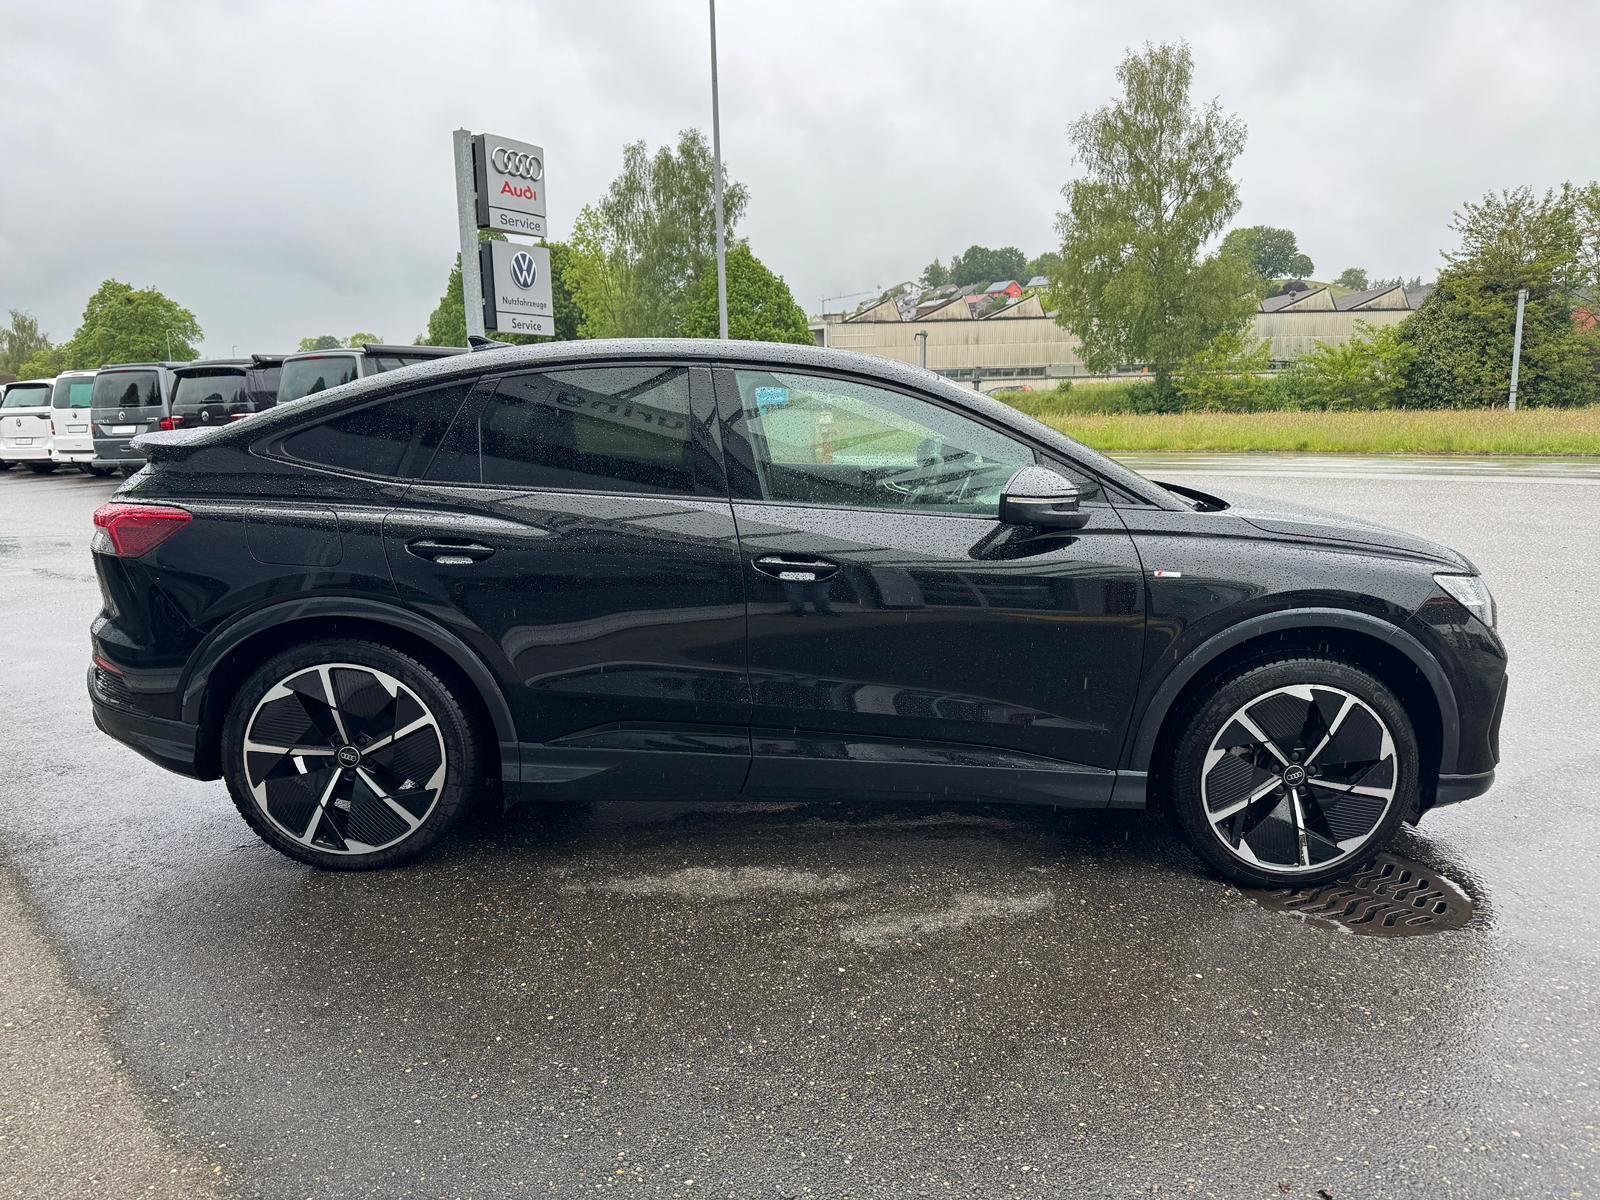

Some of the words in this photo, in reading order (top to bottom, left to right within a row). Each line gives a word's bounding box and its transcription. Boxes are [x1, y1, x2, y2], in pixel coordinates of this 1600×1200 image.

[500, 181, 537, 201] Audi
[500, 213, 541, 231] Service
[502, 296, 547, 310] Nutzfahrzeuge
[512, 318, 542, 331] Service
